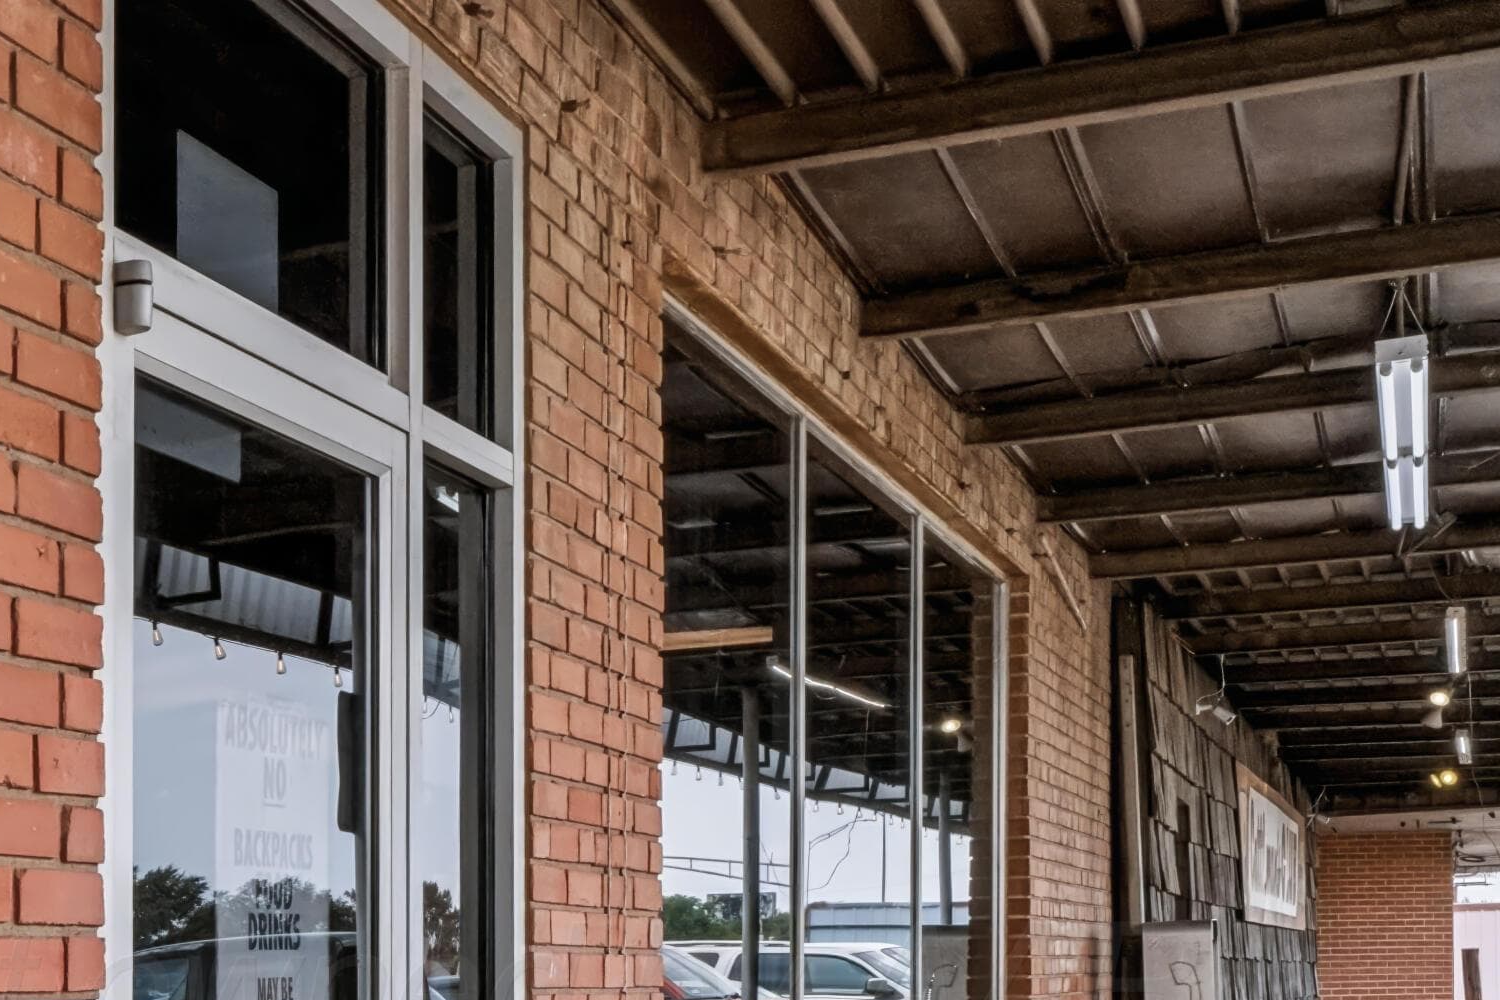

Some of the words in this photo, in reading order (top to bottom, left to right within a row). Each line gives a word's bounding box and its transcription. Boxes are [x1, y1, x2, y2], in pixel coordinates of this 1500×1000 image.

[223, 704, 324, 760] ABSOLUTELY
[262, 756, 287, 800] NO
[234, 827, 313, 870] BACKPACKS
[248, 912, 301, 951] DRINKS
